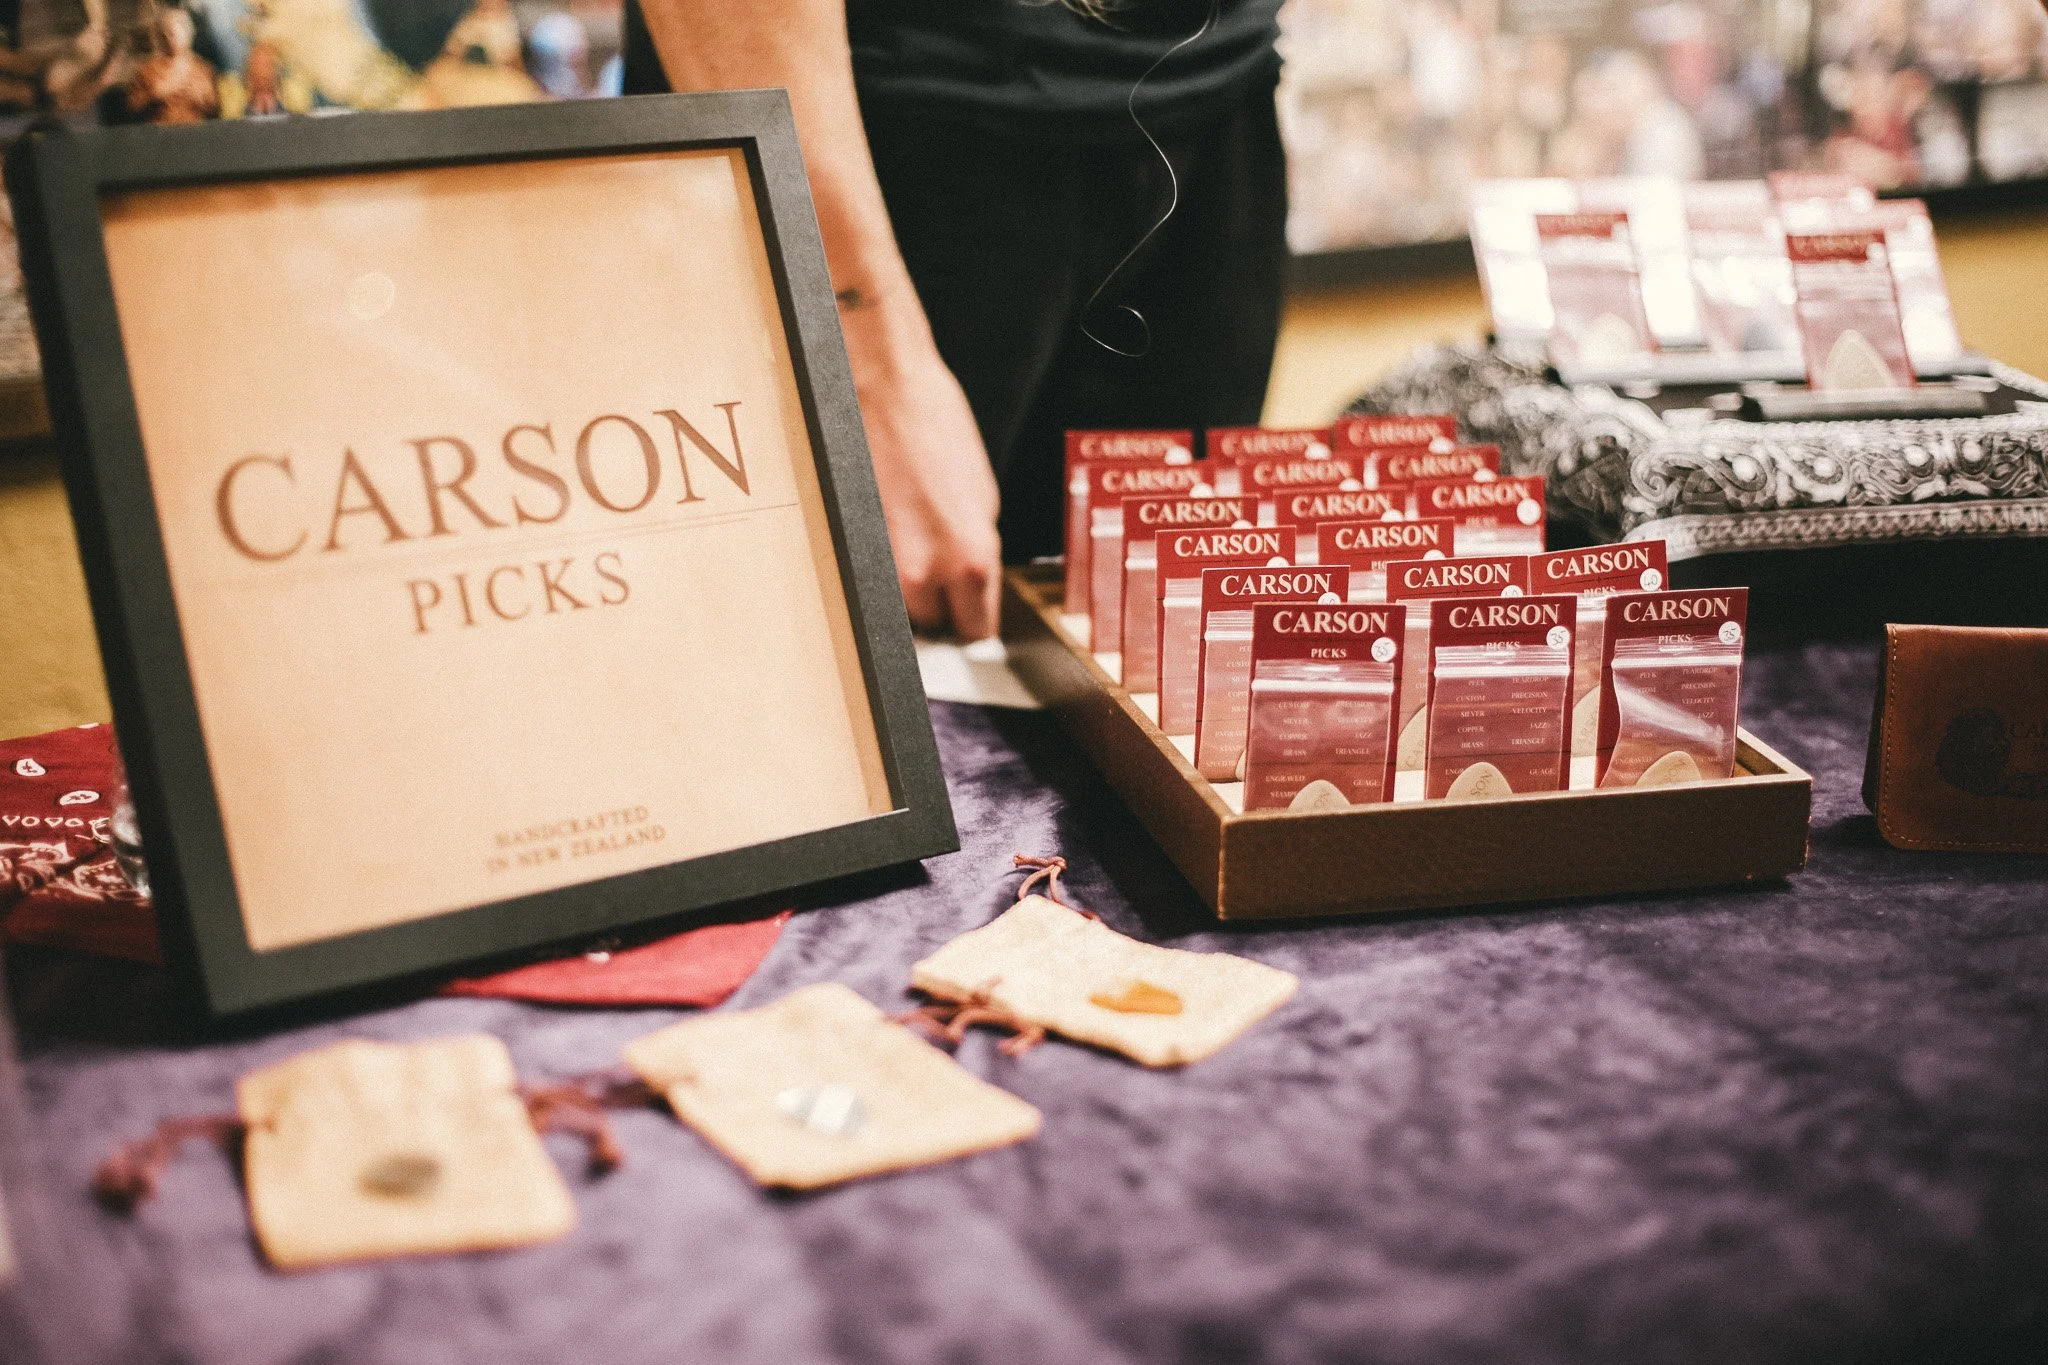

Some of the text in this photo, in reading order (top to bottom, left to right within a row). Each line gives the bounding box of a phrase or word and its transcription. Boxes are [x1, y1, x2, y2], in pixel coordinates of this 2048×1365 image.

[216, 401, 751, 562] CARSON
[1291, 492, 1392, 518] CARSON
[1432, 482, 1531, 509] CARSON
[1139, 500, 1243, 524] CARSON
[1174, 532, 1281, 557] CARSON
[1335, 524, 1439, 549] CARSON
[1546, 547, 1650, 579] CARSON
[1220, 573, 1332, 596] CARSON
[1404, 563, 1512, 588] CARSON
[407, 552, 631, 635] PICKS
[1449, 603, 1561, 629] CARSON
[1624, 597, 1730, 623] CARSON
[1272, 611, 1389, 634] CARSON
[1550, 631, 1566, 646] 35
[1658, 634, 1692, 645] PICKS
[1310, 648, 1347, 659] PICKS
[1511, 691, 1548, 700] PRECISION
[1681, 682, 1716, 690] PRECISION
[1512, 706, 1548, 715] VELOCITY
[1681, 697, 1715, 705] VELOCITY
[1460, 710, 1486, 718] SILVER
[1461, 741, 1484, 749] BRASS
[1511, 737, 1546, 746] TRIANGLE
[571, 824, 667, 859] ZEALAND
